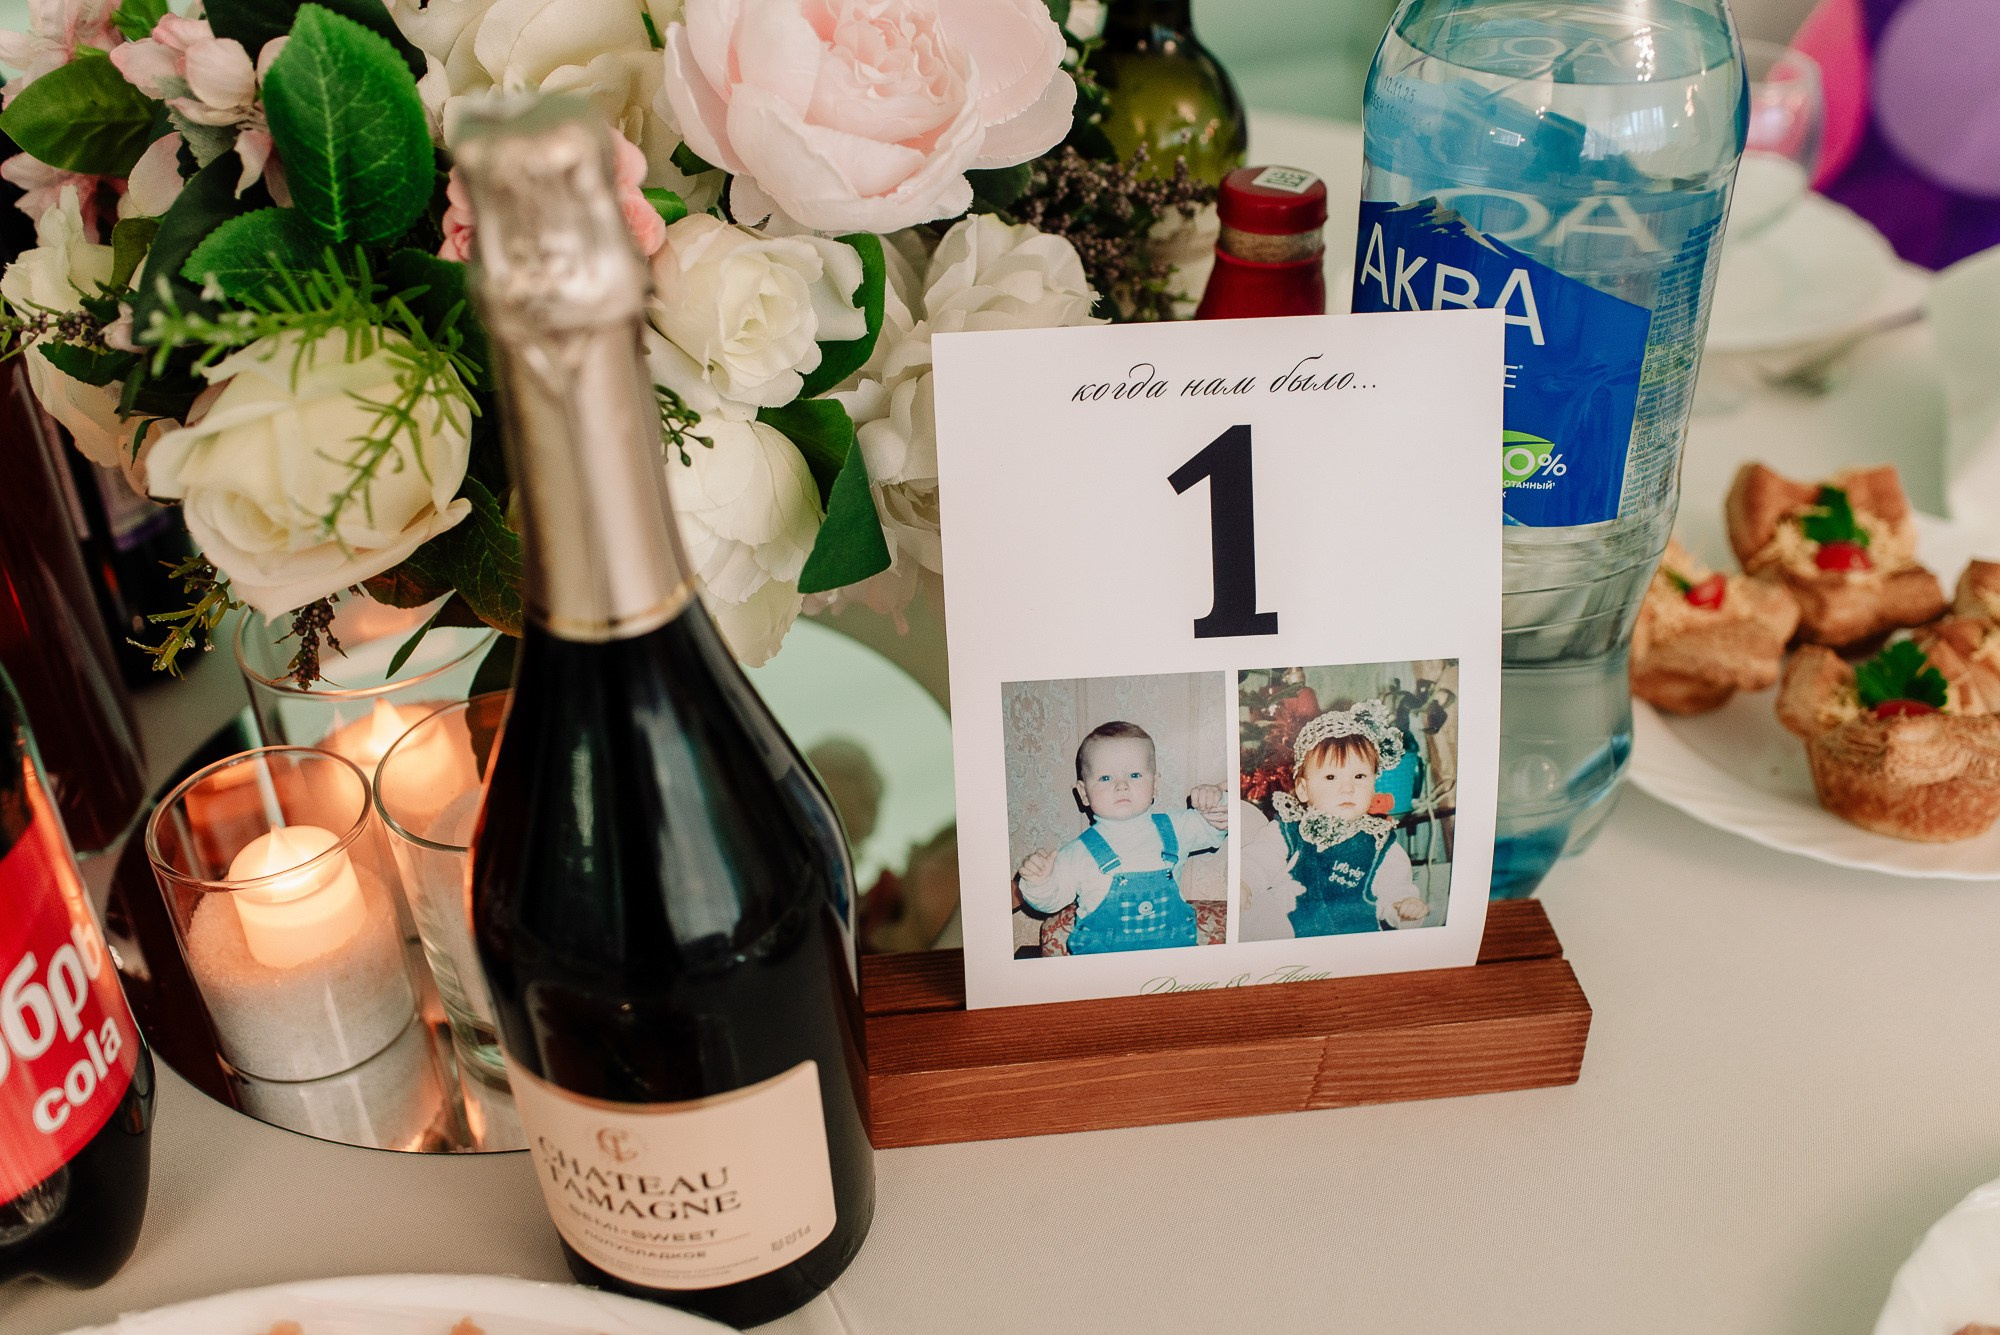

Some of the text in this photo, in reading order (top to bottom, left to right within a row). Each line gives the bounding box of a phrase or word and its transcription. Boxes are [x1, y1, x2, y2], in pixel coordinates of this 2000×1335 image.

[1360, 221, 1546, 346] АКВА
[1071, 362, 1169, 402] когда
[1180, 375, 1257, 397] нам
[1167, 423, 1279, 640] 1
[33, 1016, 124, 1134] cola
[538, 1135, 729, 1196] CHATEAU
